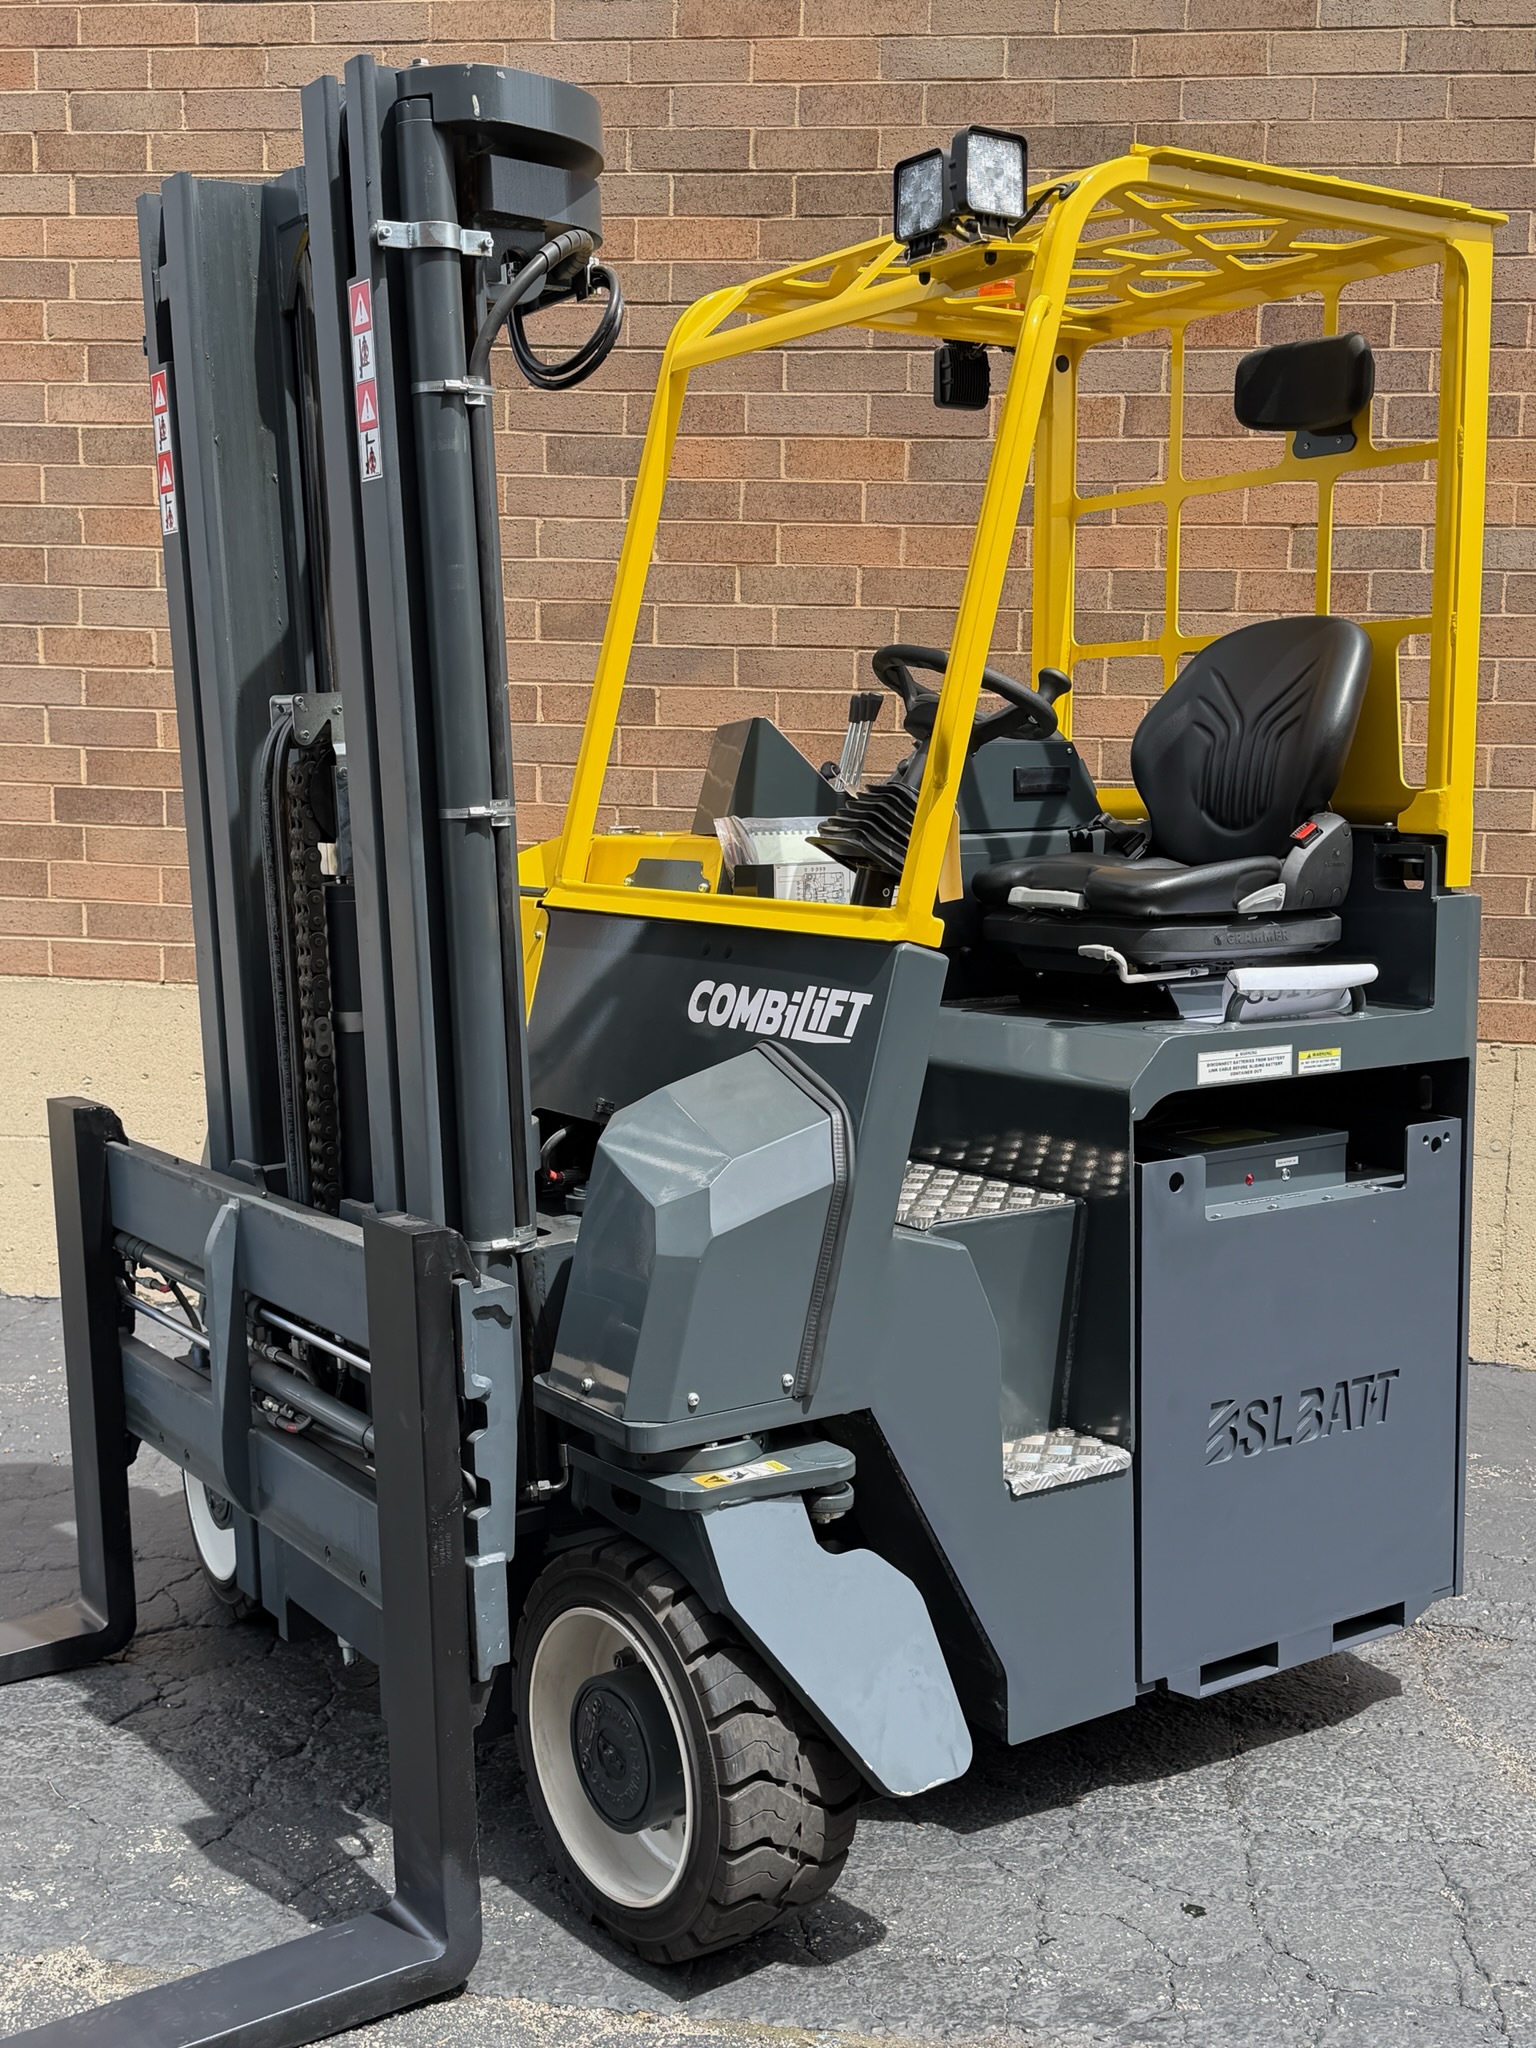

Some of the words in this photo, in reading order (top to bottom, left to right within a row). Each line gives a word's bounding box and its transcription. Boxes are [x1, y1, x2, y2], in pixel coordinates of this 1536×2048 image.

[1226, 930, 1290, 945] GRAMMER
[1206, 1060, 1233, 1068] DISCONNECT
[1204, 1368, 1400, 1467] BSLBATT
